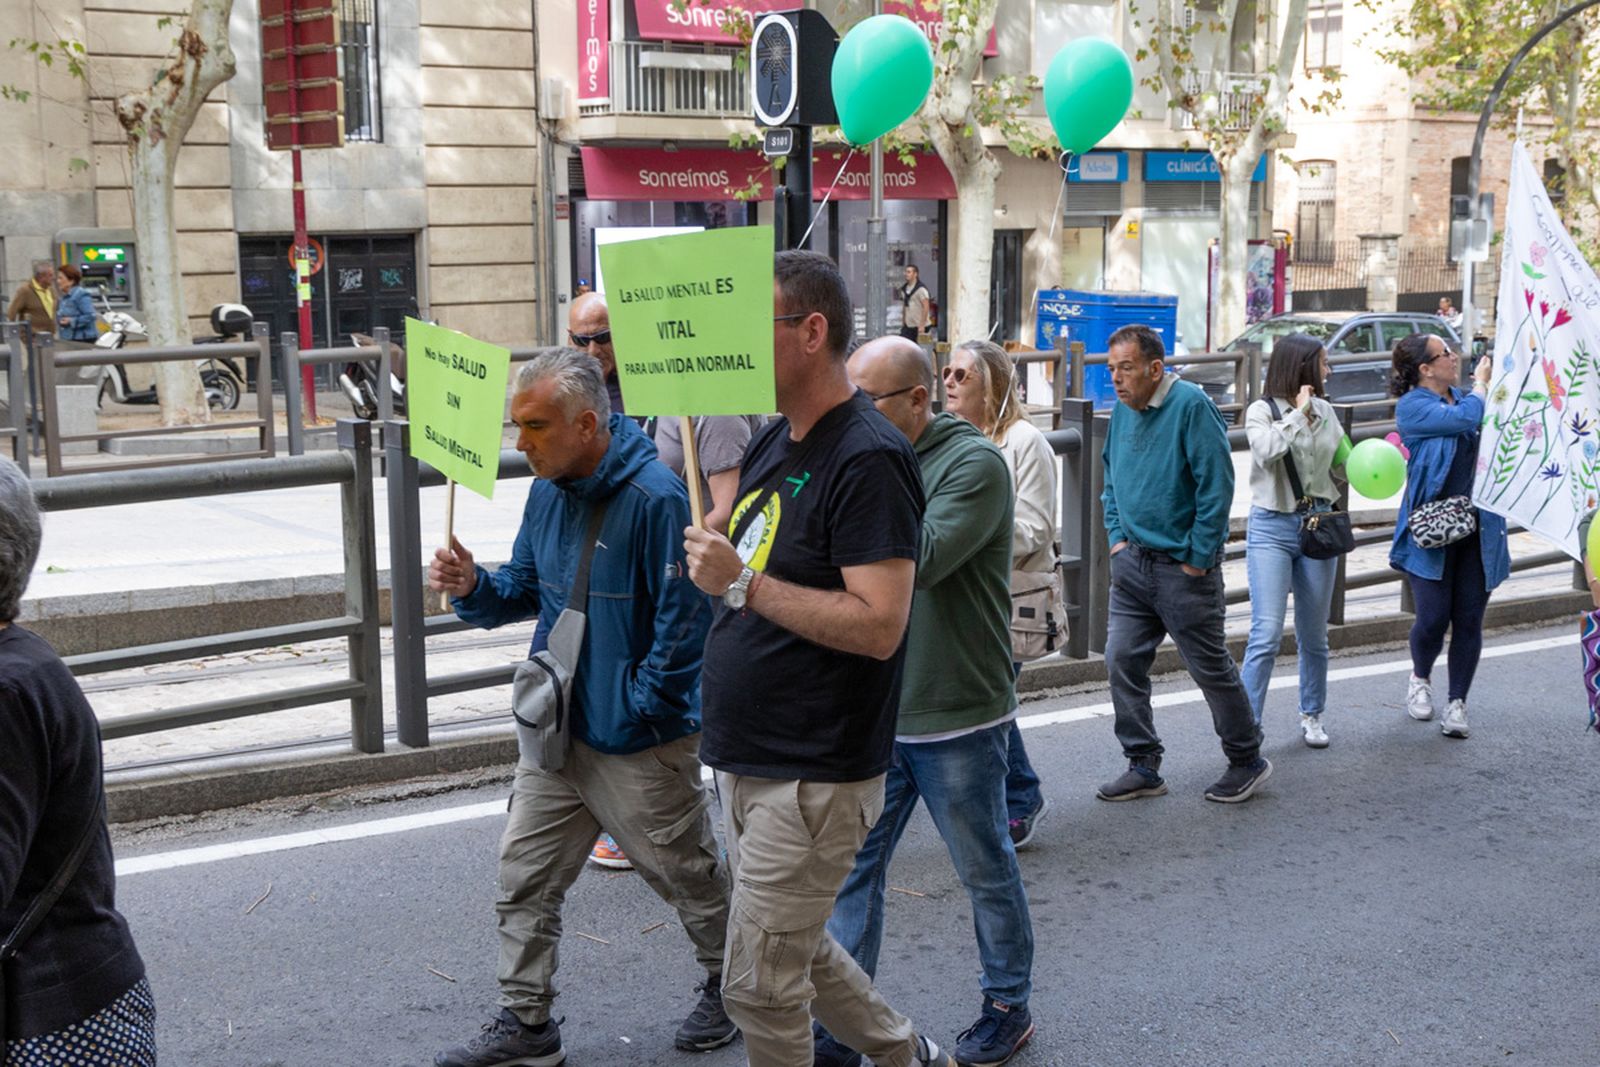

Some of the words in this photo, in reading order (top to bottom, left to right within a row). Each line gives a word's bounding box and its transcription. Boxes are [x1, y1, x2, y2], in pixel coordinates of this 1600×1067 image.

[771, 136, 788, 147] S101
[1167, 158, 1208, 173] CLÍNICA
[634, 286, 664, 303] SALUD
[666, 281, 712, 300] MENTAL
[715, 277, 734, 295] ES
[657, 320, 696, 340] VITAL
[424, 346, 436, 361] No
[438, 351, 451, 369] hay
[452, 353, 487, 380] SALUD
[625, 362, 648, 376] PARA
[648, 361, 665, 375] UNA
[665, 357, 695, 375] VIDA
[696, 354, 756, 373] NORMAL
[447, 391, 461, 410] SIN
